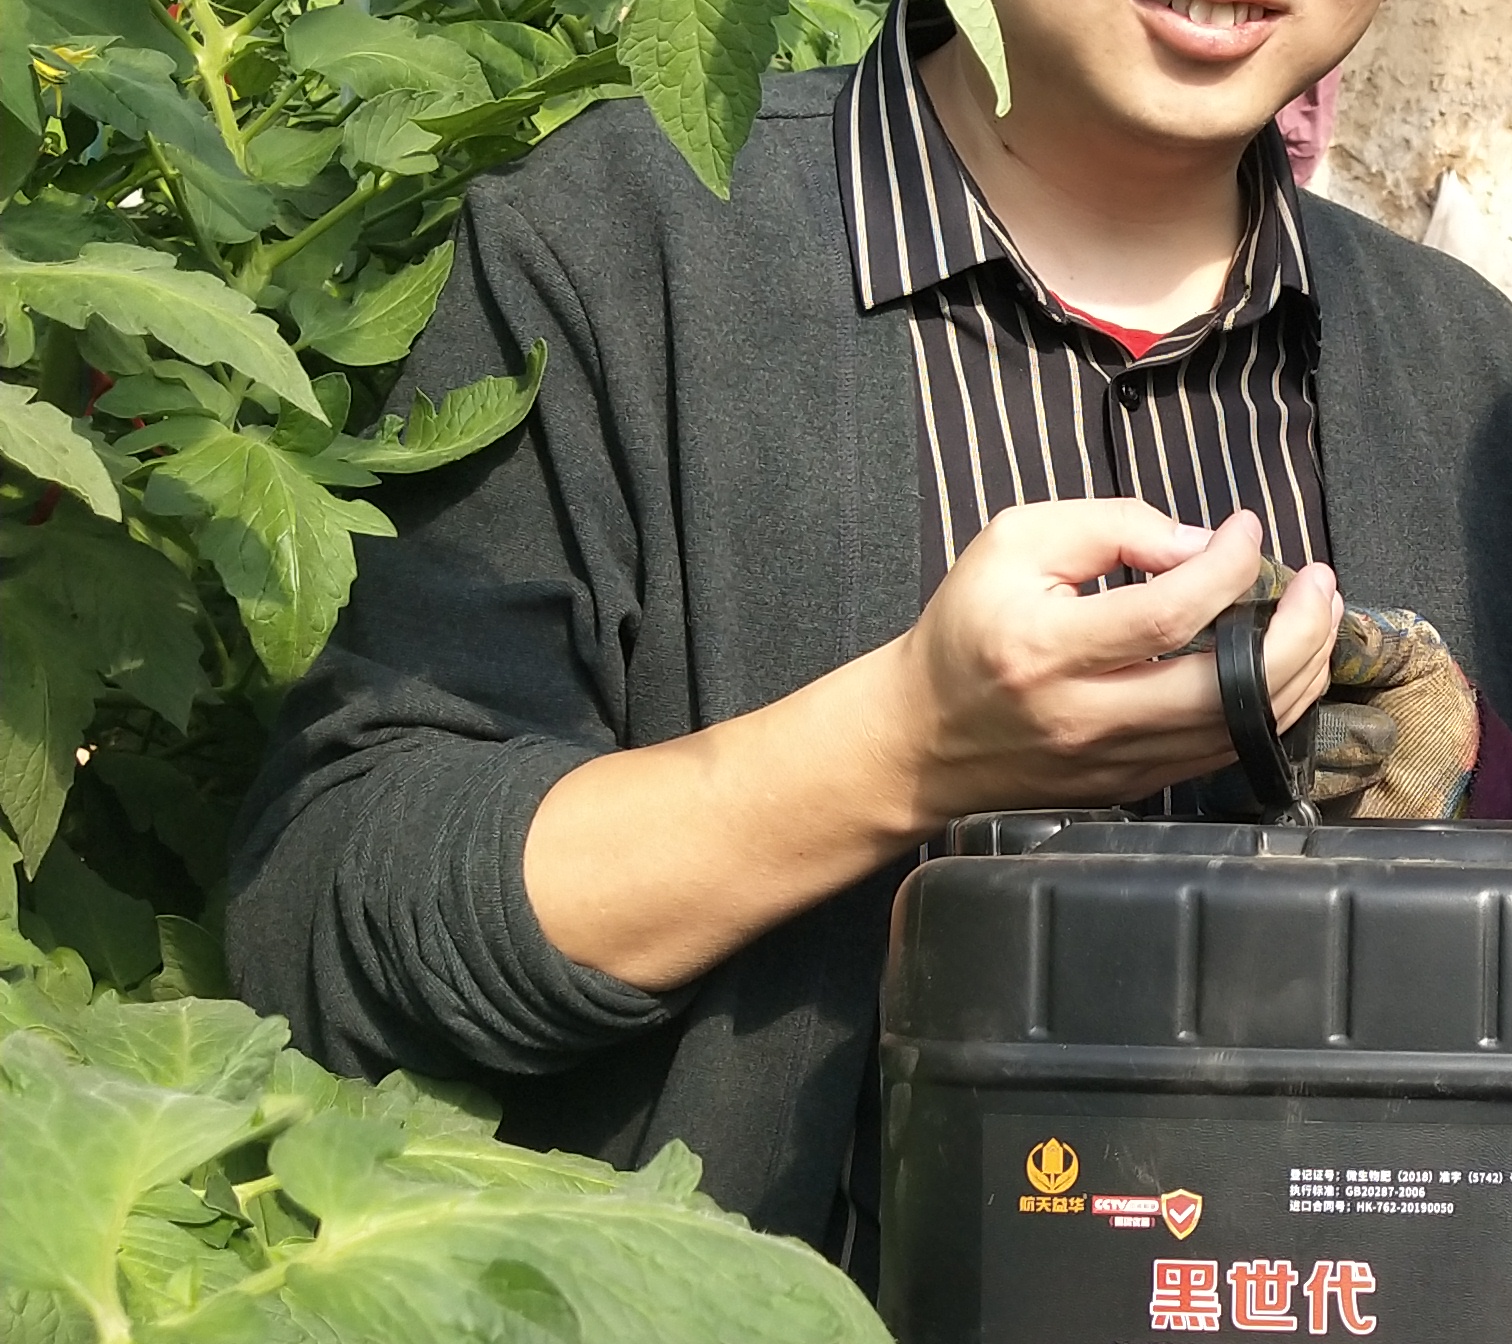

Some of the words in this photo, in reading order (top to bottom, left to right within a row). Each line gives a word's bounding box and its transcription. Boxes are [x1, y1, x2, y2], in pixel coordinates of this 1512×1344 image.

[1019, 1195, 1085, 1213] 航天益华
[1150, 1259, 1377, 1335] 黑世代
